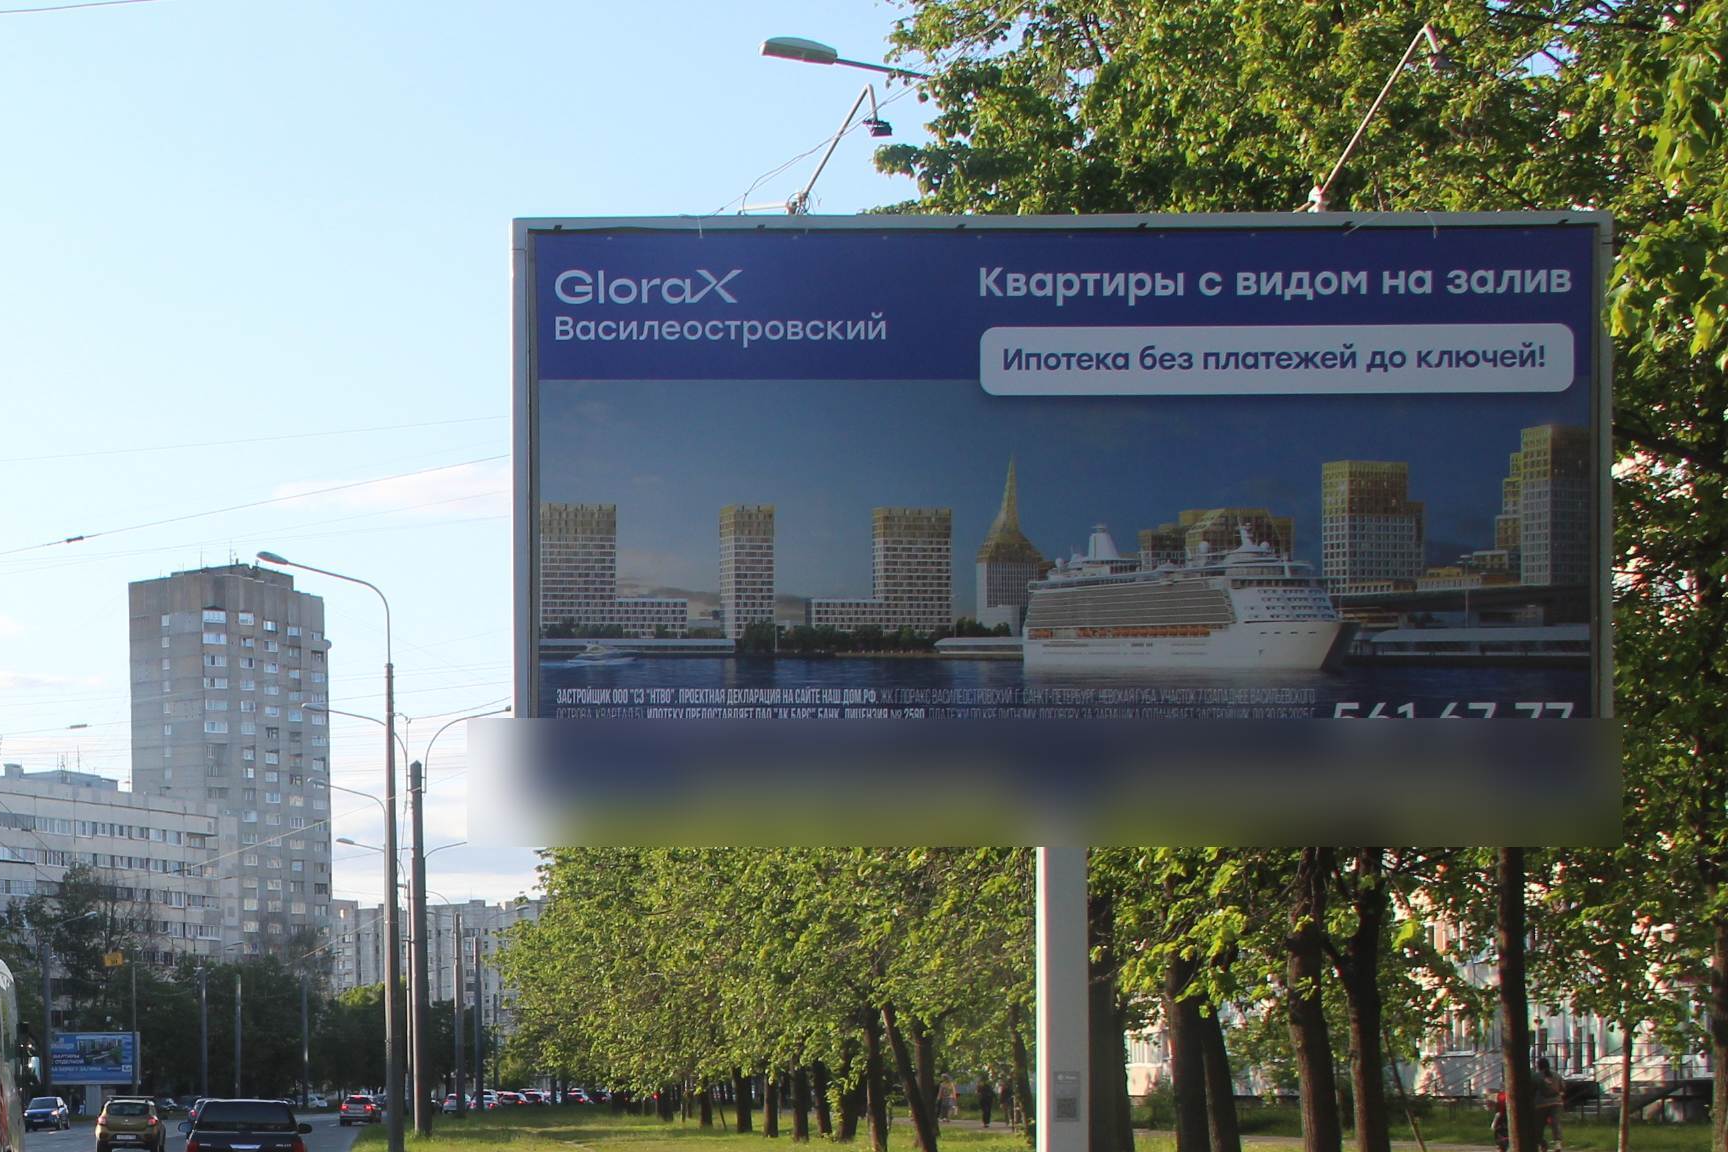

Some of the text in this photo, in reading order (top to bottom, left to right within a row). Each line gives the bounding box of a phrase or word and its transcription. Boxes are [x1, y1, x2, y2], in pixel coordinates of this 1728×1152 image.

[554, 269, 743, 304] GloraX
[978, 266, 1573, 306] Квартиры с видом на залив
[554, 311, 888, 347] Василеостровский
[1002, 342, 1547, 373] Ипотека без платежей до ключей!
[556, 686, 611, 705] ЗАСТРОЙЩИК
[612, 688, 628, 704] ООО
[679, 688, 725, 704] ПРОЕКТНАЯ
[727, 688, 781, 705] ДЕКЛАРАЦИЯ
[782, 688, 793, 704] НА
[795, 686, 821, 704] САЙТЕ
